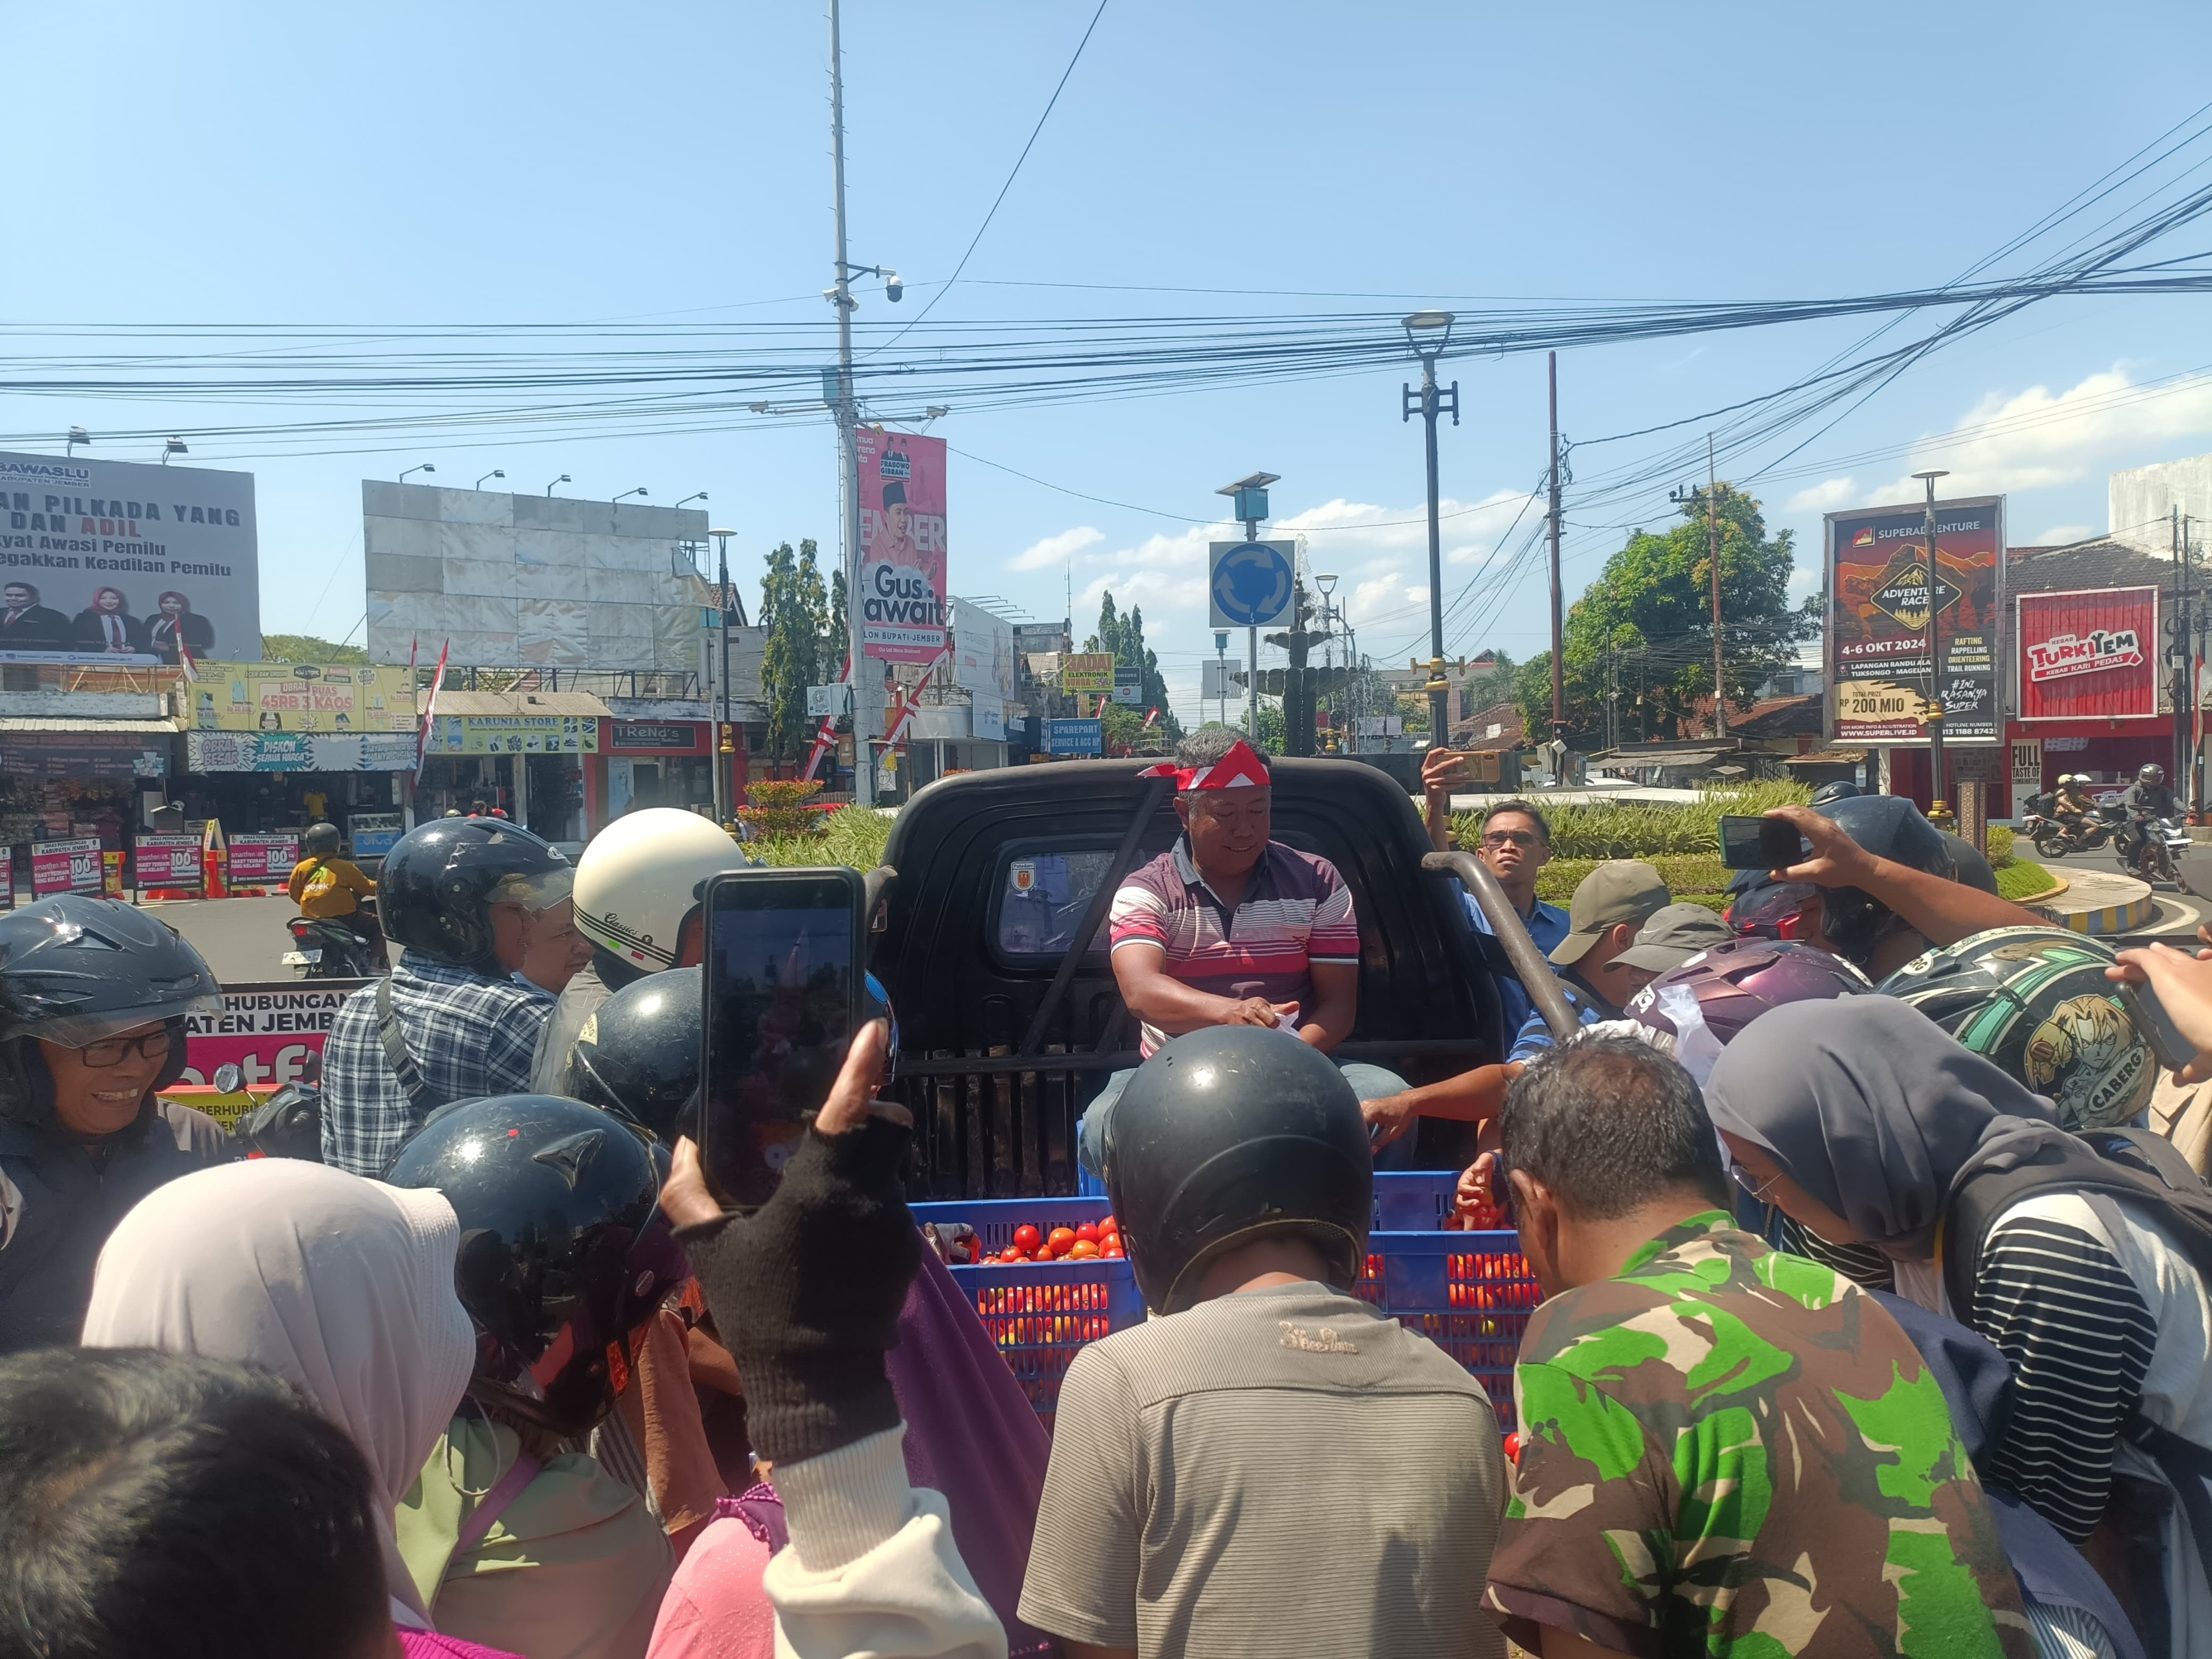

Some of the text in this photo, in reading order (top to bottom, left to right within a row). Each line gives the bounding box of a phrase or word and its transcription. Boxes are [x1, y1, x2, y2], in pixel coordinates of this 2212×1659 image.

[857, 436, 874, 445] mua
[858, 446, 876, 455] rena
[881, 460, 910, 470] PRABOWO
[881, 467, 903, 476] GIBRAN
[53, 480, 90, 488] JEMBER
[45, 495, 161, 521] PILKADA
[173, 505, 240, 526] YANG
[11, 512, 142, 537] DAN ADIL
[1878, 521, 1980, 539] SUPERADENTURE
[40, 535, 97, 552] Awasi
[103, 540, 165, 556] Pemilu
[85, 556, 165, 573] Keadilan
[171, 560, 231, 576] Pemilu
[875, 564, 923, 600] Gus
[864, 589, 944, 626] await
[1901, 596, 1930, 606] RACE
[882, 632, 909, 641] BUPATI
[1955, 637, 1982, 646] RAFTING
[2051, 637, 2074, 646] KEBAB
[1842, 638, 1926, 656] 4-6 OKT 2024
[1951, 646, 1988, 655] RAPPELLING
[1066, 653, 1112, 672] GADAI
[1948, 655, 1990, 664] ORIENTEERING
[2071, 663, 2091, 672] KARI
[2094, 656, 2124, 667] PEDAS
[283, 682, 306, 692] OBRAL
[261, 694, 299, 709] 45RB
[315, 696, 353, 711] KAOS
[1853, 699, 1876, 713] 200
[1880, 698, 1905, 713] MIO
[1943, 701, 1979, 711] SUPER
[467, 717, 558, 726] KARUNIA STORE
[1053, 725, 1098, 734] SPAREPART
[202, 739, 237, 753] OBRAL
[264, 740, 296, 753] DISKON
[1051, 738, 1074, 747] SERVICE
[1080, 737, 1091, 747] ACC
[1093, 737, 1100, 746] HP
[204, 751, 239, 766] BESAR
[2012, 745, 2040, 767] FULL
[2012, 767, 2040, 778] TASTE OF
[171, 852, 191, 867] 100
[266, 850, 288, 864] 100
[70, 858, 91, 875] 100
[305, 882, 329, 892] gojek
[604, 912, 638, 935] Classics
[225, 993, 348, 1011] HUBUNGAN
[186, 1012, 335, 1034] ATEN JEMB
[2092, 1052, 2142, 1108] CABERG
